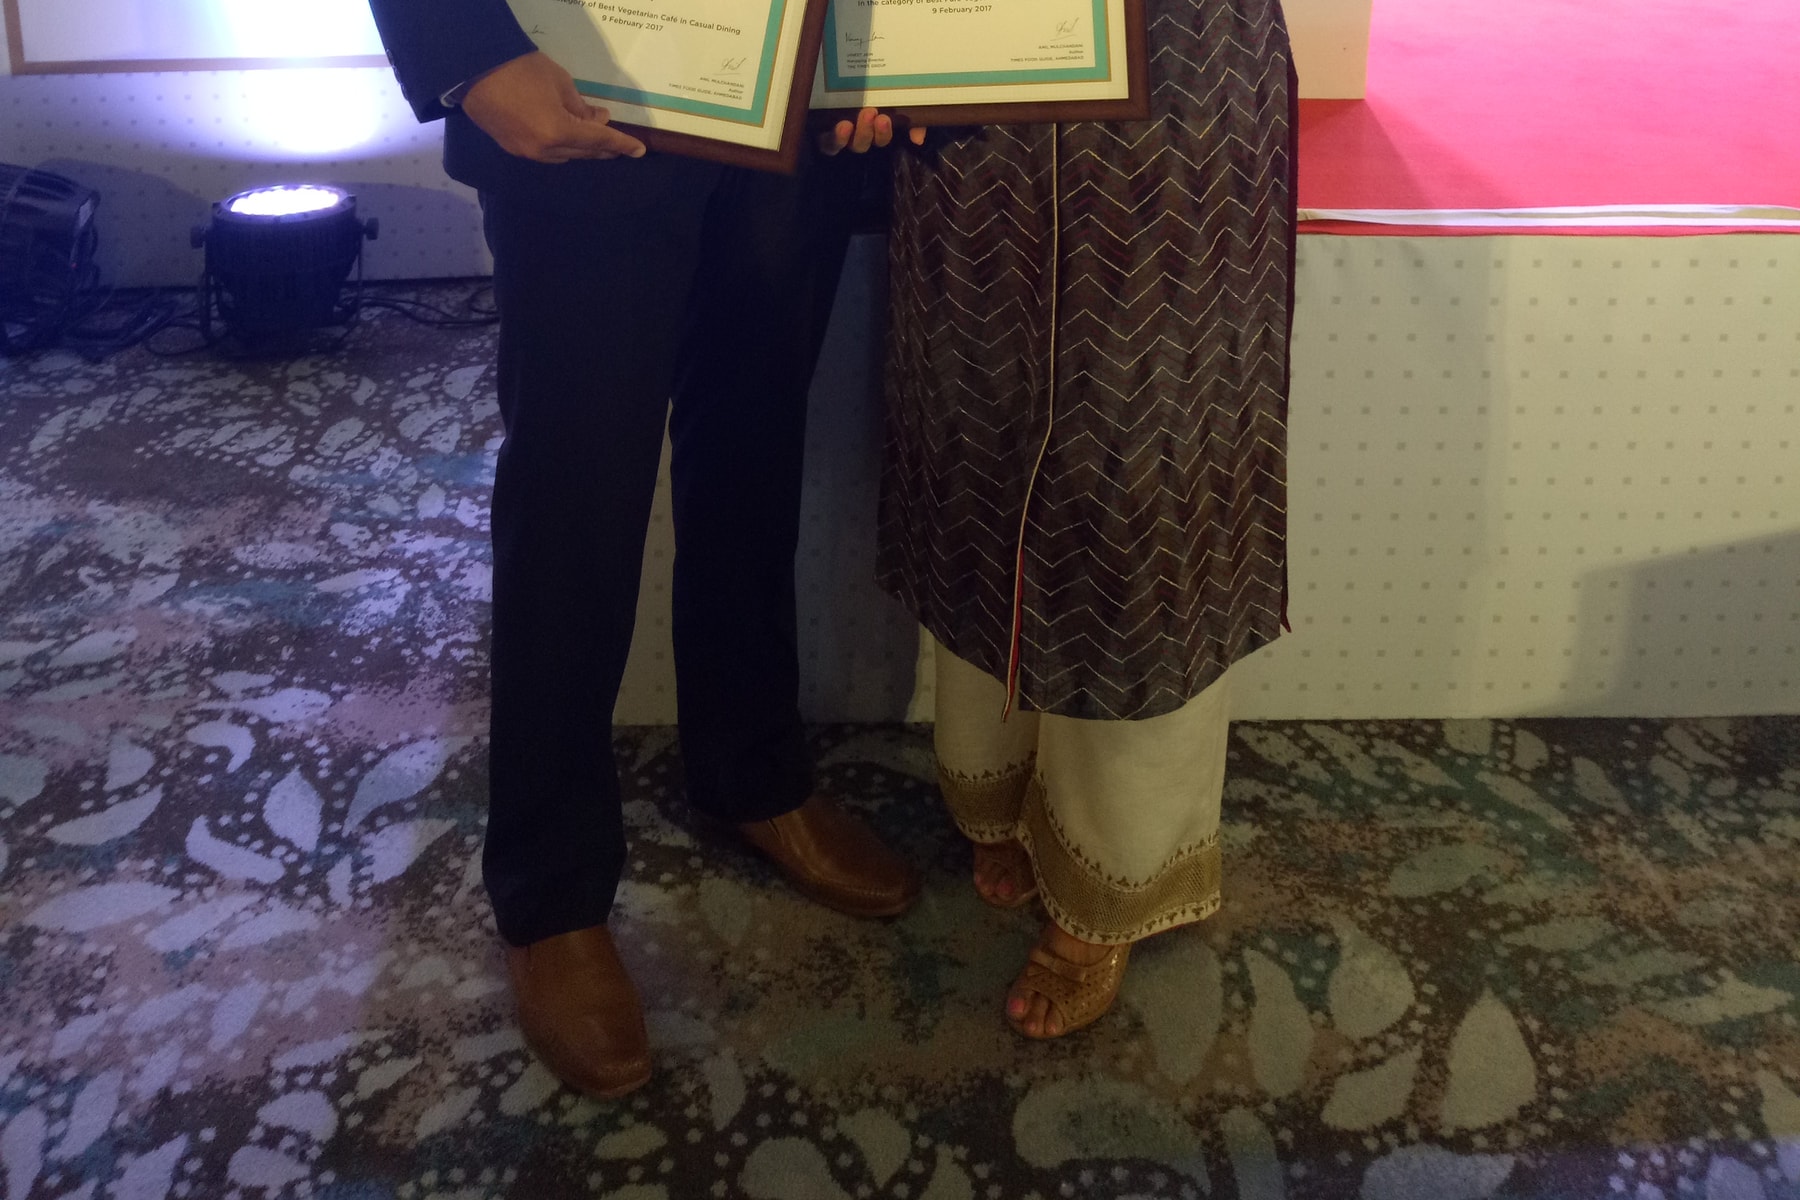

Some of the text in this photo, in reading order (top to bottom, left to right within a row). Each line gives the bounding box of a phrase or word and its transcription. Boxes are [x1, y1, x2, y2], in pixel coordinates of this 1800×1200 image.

[940, 6, 972, 14] February
[598, 2, 615, 12] Best
[618, 6, 658, 20] Vegetarian
[660, 13, 678, 23] Café
[680, 17, 687, 25] in
[689, 19, 714, 30] Casual
[716, 24, 741, 36] Dining
[609, 16, 643, 29] February
[645, 22, 664, 32] 2017
